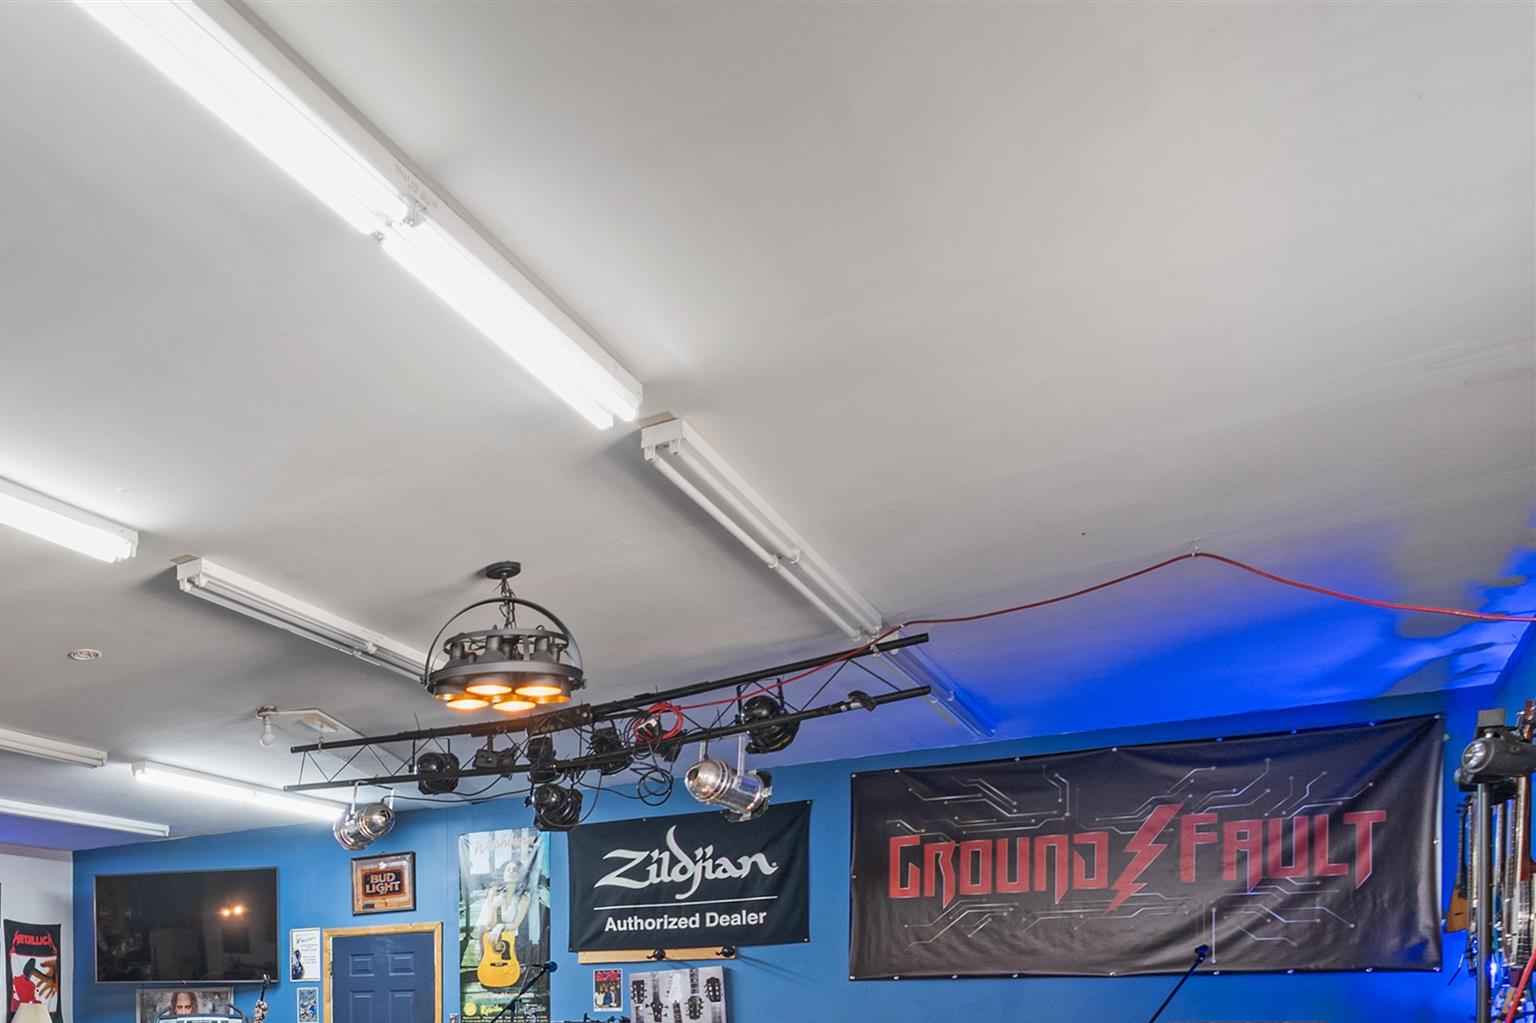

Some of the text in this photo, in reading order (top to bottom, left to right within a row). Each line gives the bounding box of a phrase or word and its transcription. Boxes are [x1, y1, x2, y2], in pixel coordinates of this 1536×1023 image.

[593, 825, 779, 900] Zildjian
[889, 810, 1387, 909] GROUND FAULT
[365, 881, 401, 894] LIGHT
[370, 872, 396, 884] BUD
[604, 910, 767, 932] Authorized Dealer
